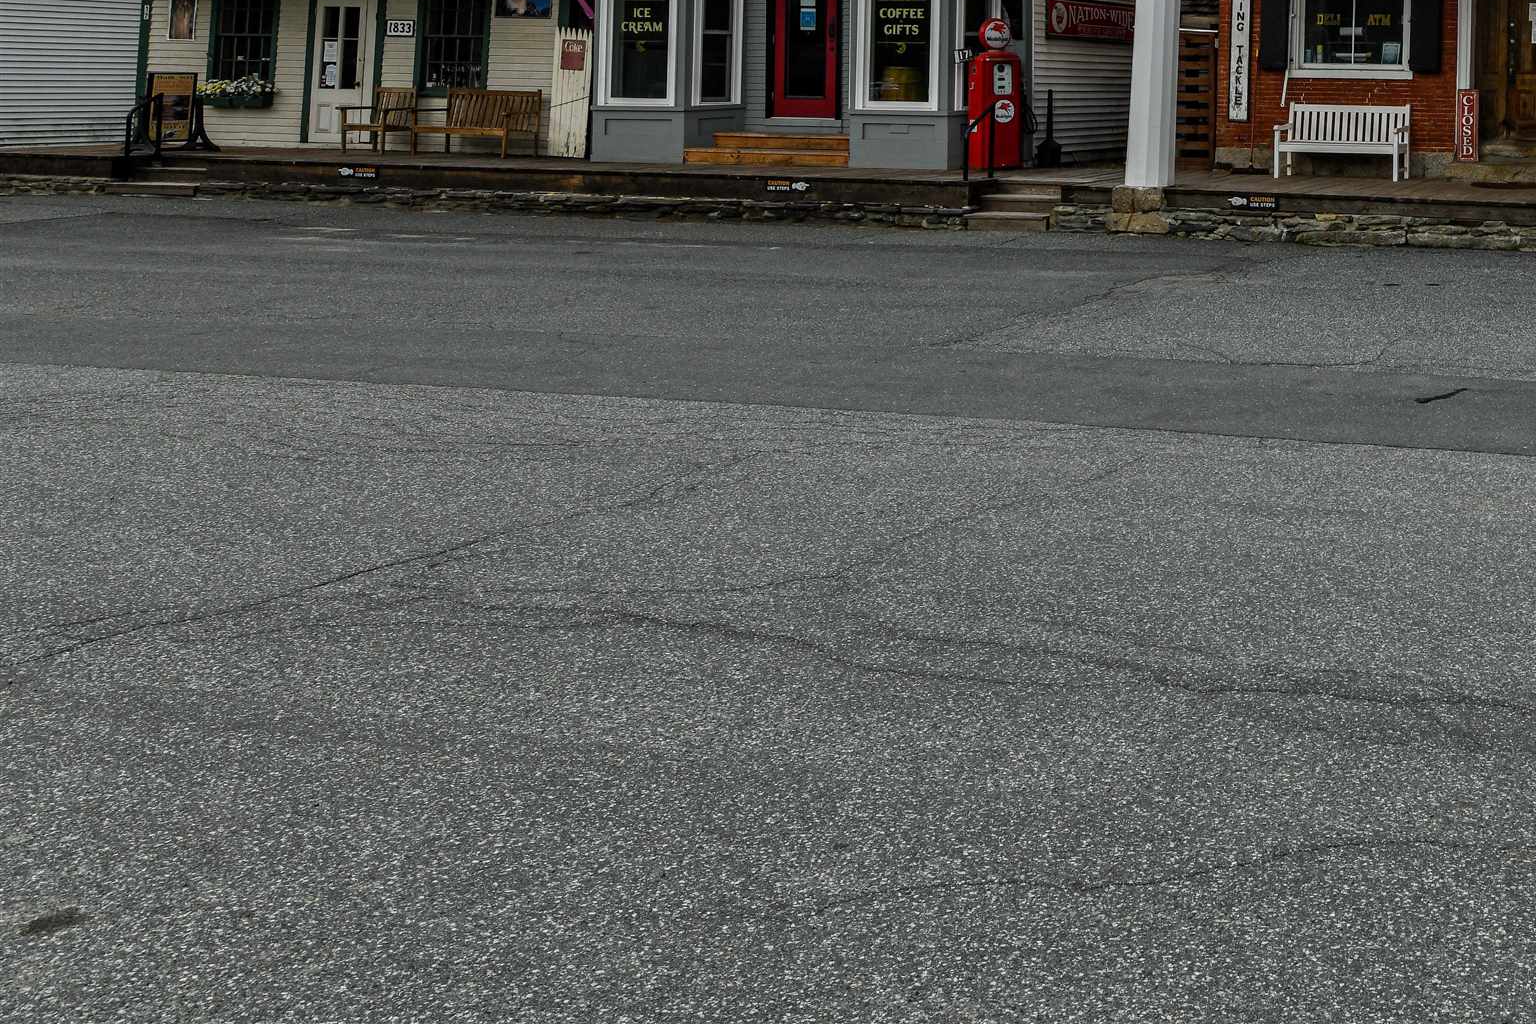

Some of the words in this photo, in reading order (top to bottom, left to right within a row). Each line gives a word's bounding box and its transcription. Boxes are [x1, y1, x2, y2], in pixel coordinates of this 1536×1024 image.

[633, 7, 652, 18] ICE
[879, 7, 925, 20] COFFEE
[1367, 13, 1392, 26] ATM
[388, 22, 412, 34] 1833
[620, 21, 663, 34] CREAM
[883, 24, 920, 36] GIFTS
[564, 40, 584, 54] Coke
[1235, 45, 1245, 106] TACKLE
[1462, 95, 1474, 156] CLOSED
